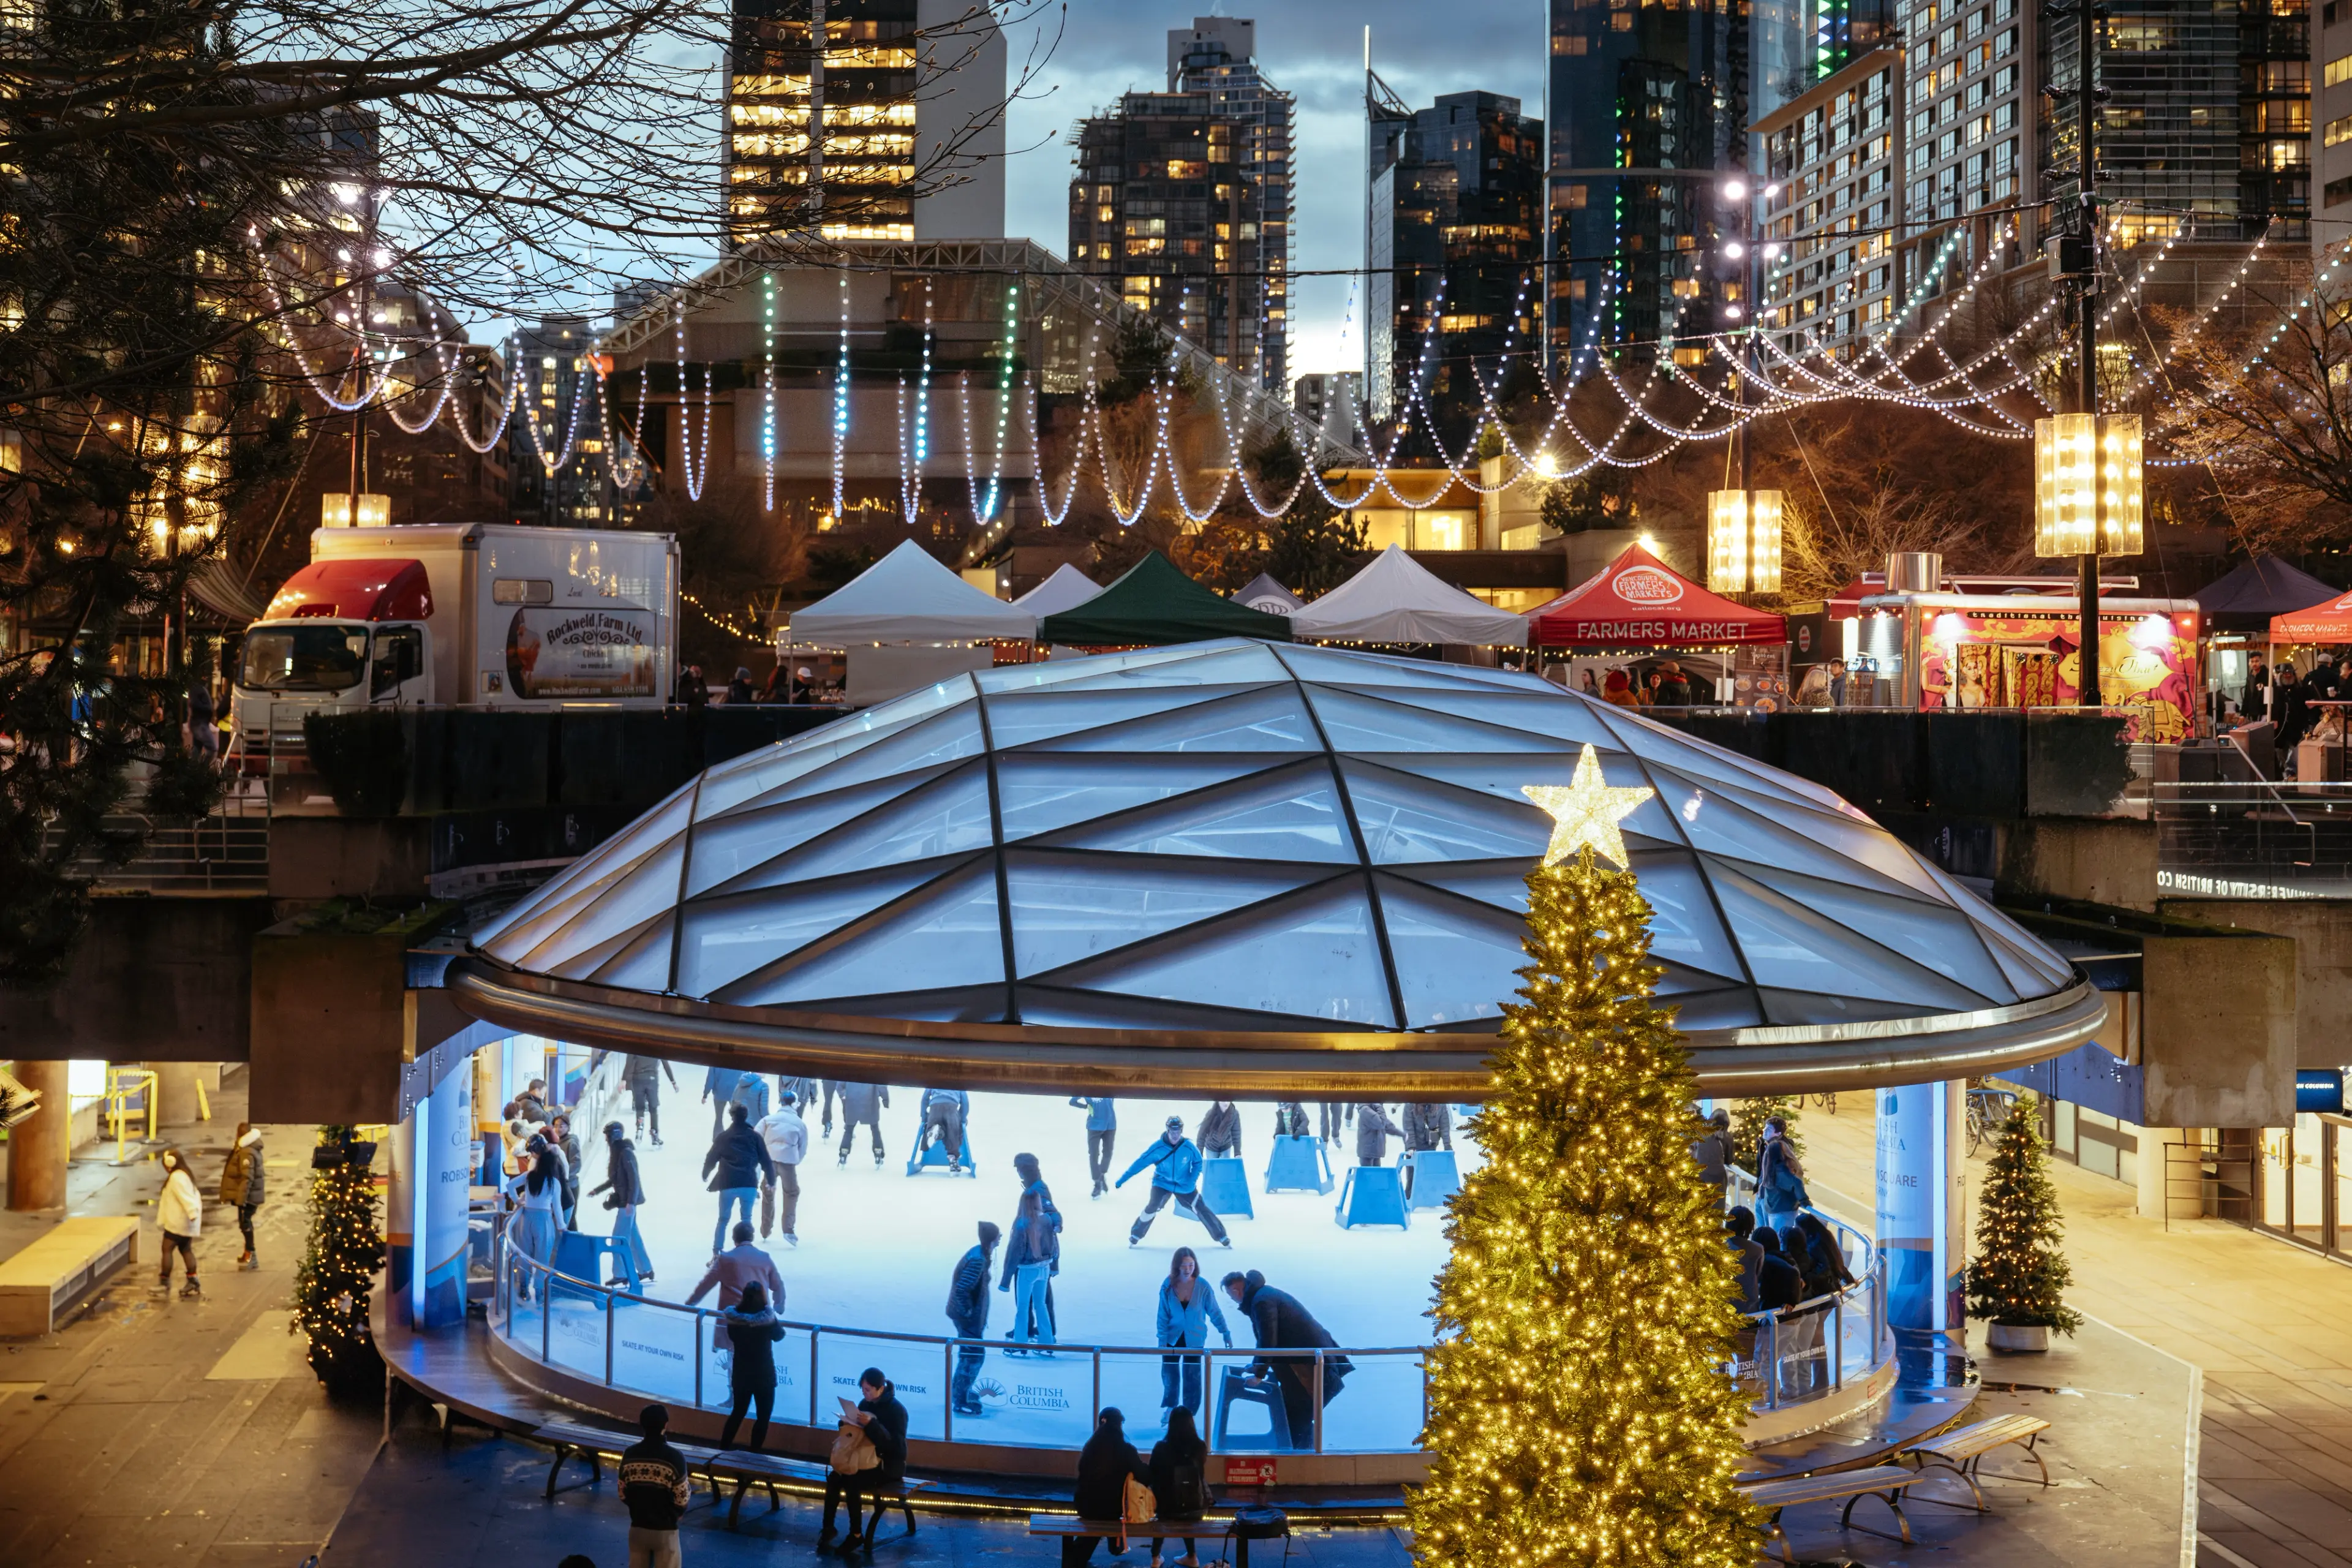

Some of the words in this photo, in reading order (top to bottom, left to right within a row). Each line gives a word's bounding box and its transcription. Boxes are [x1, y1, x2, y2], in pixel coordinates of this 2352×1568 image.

[1619, 581, 1666, 592] FARMERS
[1626, 590, 1673, 598] MARKETS
[547, 614, 595, 644] Rockweld
[598, 613, 624, 631] Farm
[627, 622, 643, 645] Ltd.
[1578, 622, 1665, 639] FARMERS
[1672, 622, 1749, 639] MARKET
[441, 1167, 469, 1183] ROBSO
[1880, 1170, 1918, 1188] SQUARE
[622, 1340, 637, 1350] SKATE
[645, 1346, 658, 1355] YOUR
[659, 1349, 672, 1358] OWN
[673, 1352, 684, 1361] RISK
[833, 1376, 856, 1386] SKATE
[895, 1383, 908, 1392] WN
[910, 1385, 926, 1393] RISK
[1017, 1385, 1063, 1397] BRITISH
[1010, 1395, 1069, 1408] COLUMBIA
